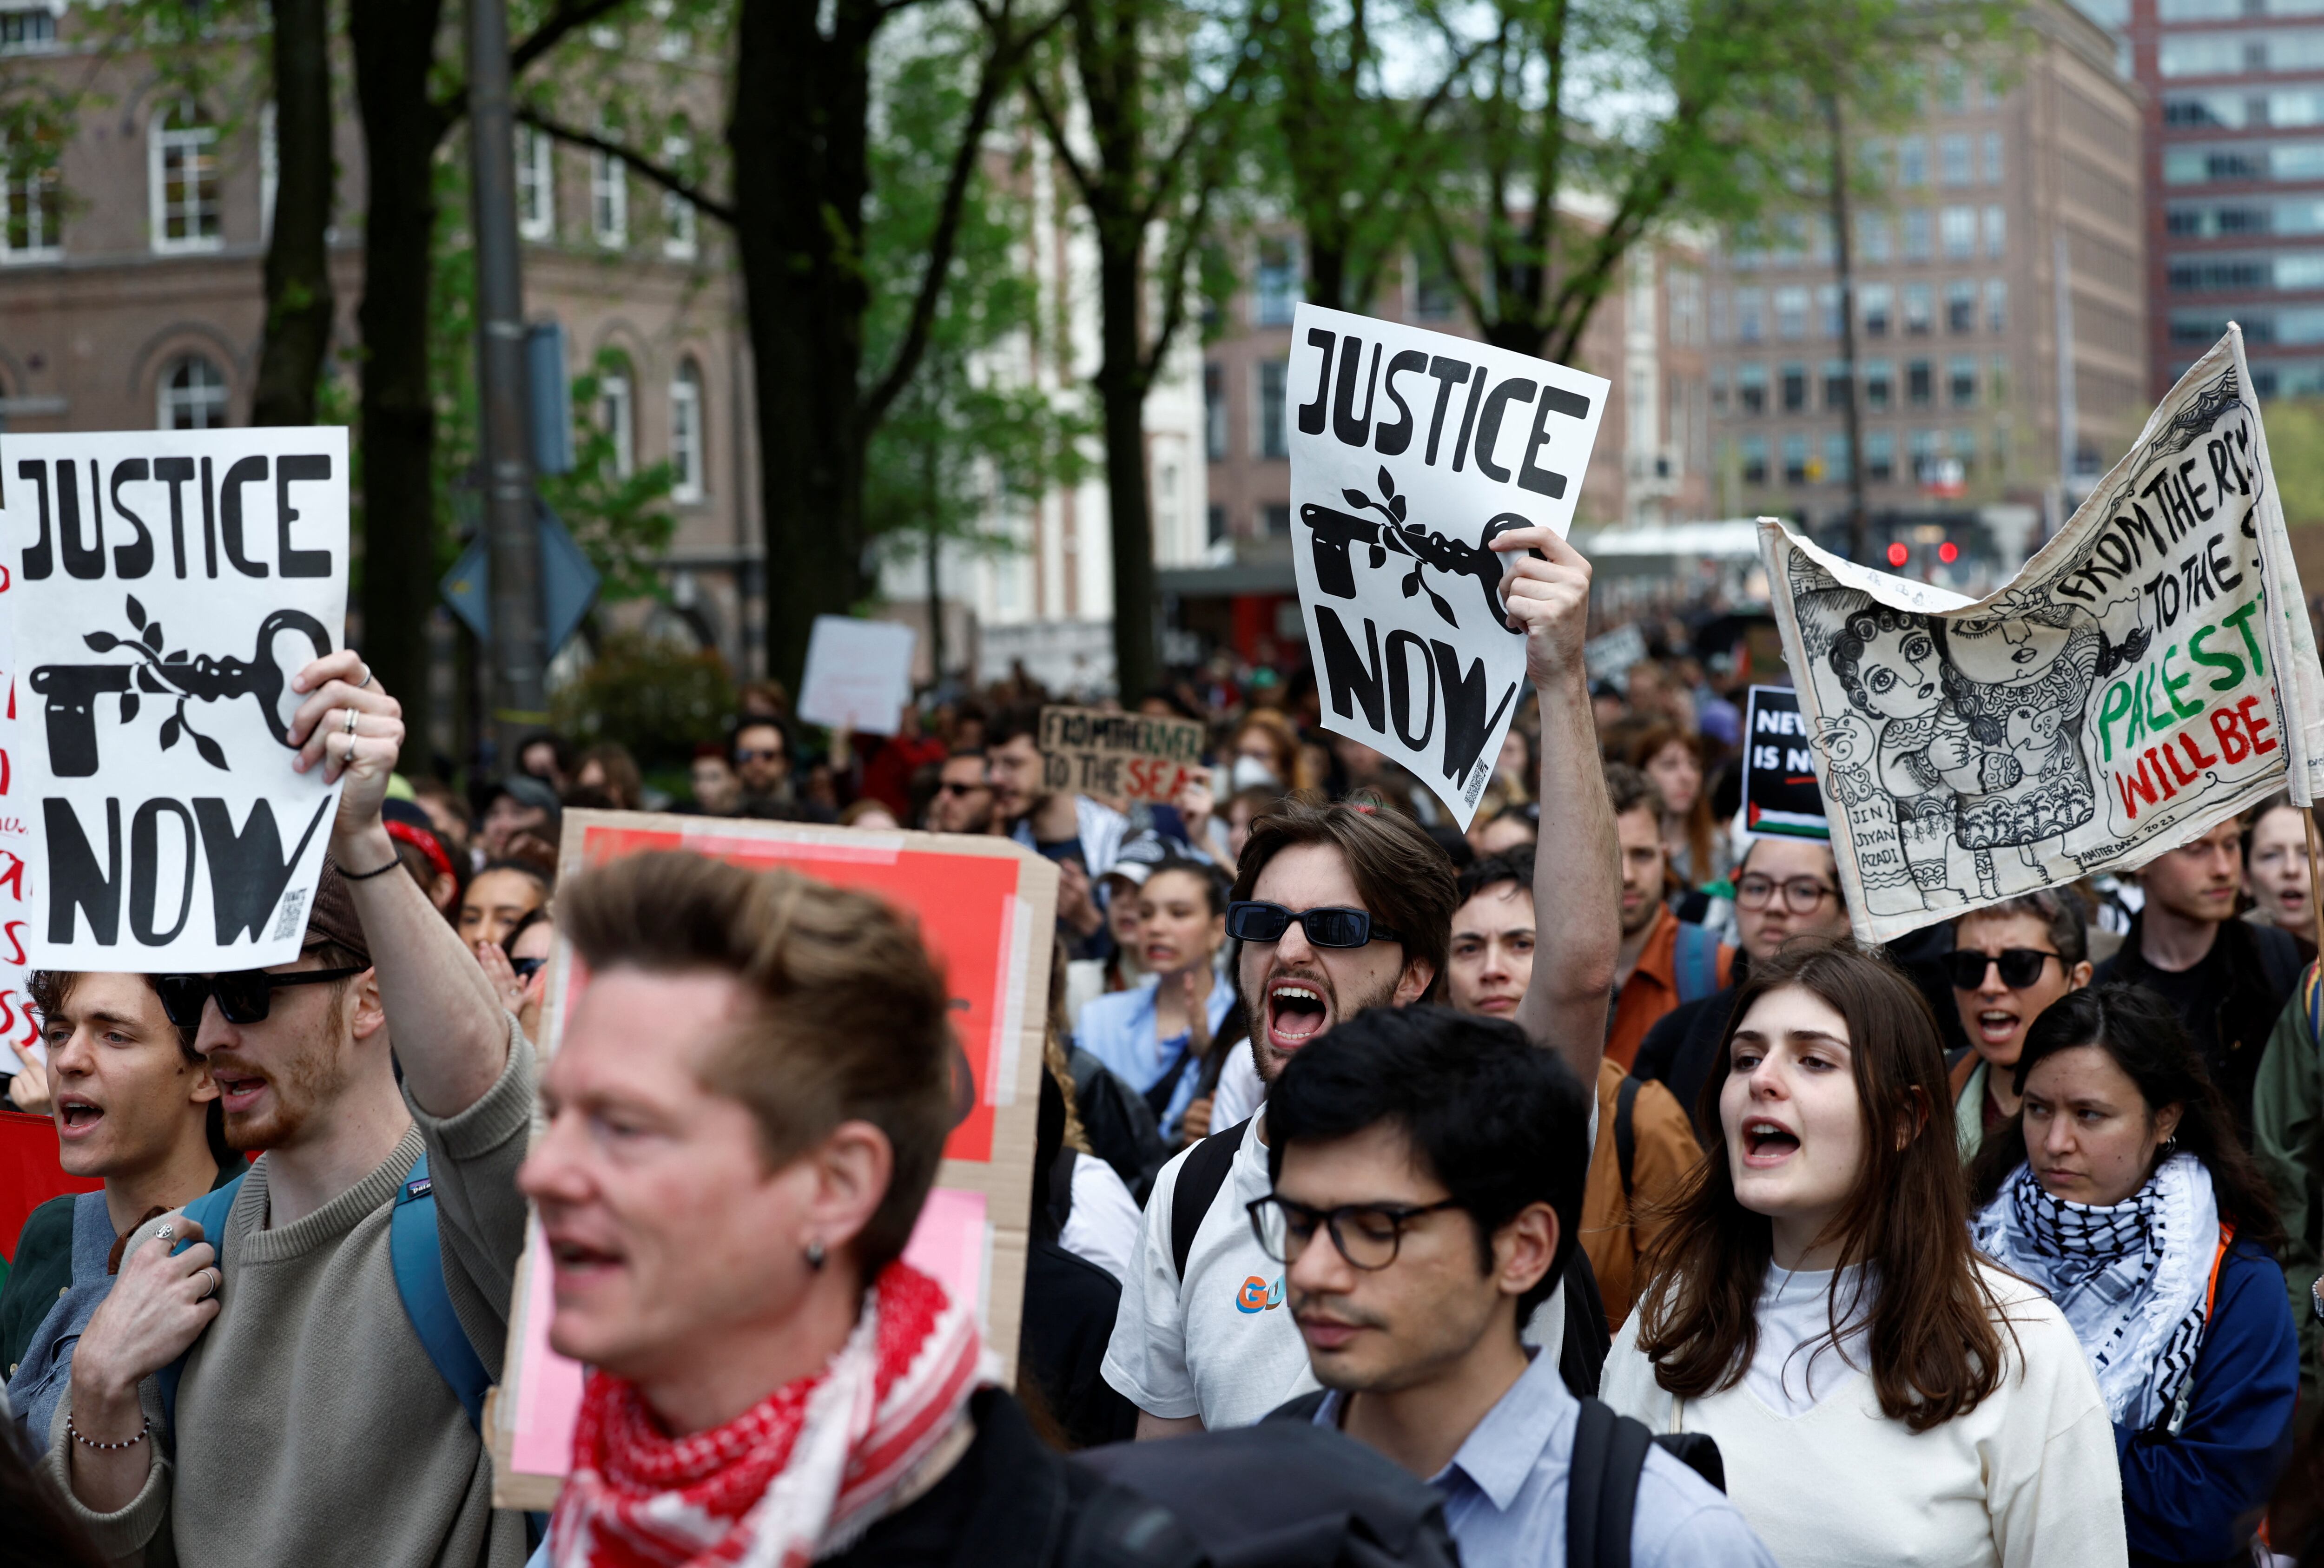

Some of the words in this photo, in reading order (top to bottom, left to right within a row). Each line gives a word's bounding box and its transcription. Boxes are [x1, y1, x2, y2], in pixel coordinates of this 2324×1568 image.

[1298, 328, 1591, 500] JUSTICE
[18, 455, 332, 580] JUSTICE
[2057, 502, 2168, 601] FROM
[2140, 458, 2214, 543] THE
[2144, 570, 2180, 633] TO
[2180, 533, 2243, 613] THE
[1314, 604, 1516, 791] NOW
[2099, 600, 2263, 763] PALEST
[1044, 752, 1070, 788] TO
[1078, 754, 1122, 796] THE
[1125, 758, 1191, 800] SEA
[1753, 744, 1780, 770] IS
[1853, 805, 1882, 824] JIN
[2116, 732, 2218, 819] WILL
[2210, 695, 2277, 764] BE
[43, 794, 332, 947] NOW
[1856, 828, 1896, 847] JIYAN
[1862, 849, 1899, 869] AZADI
